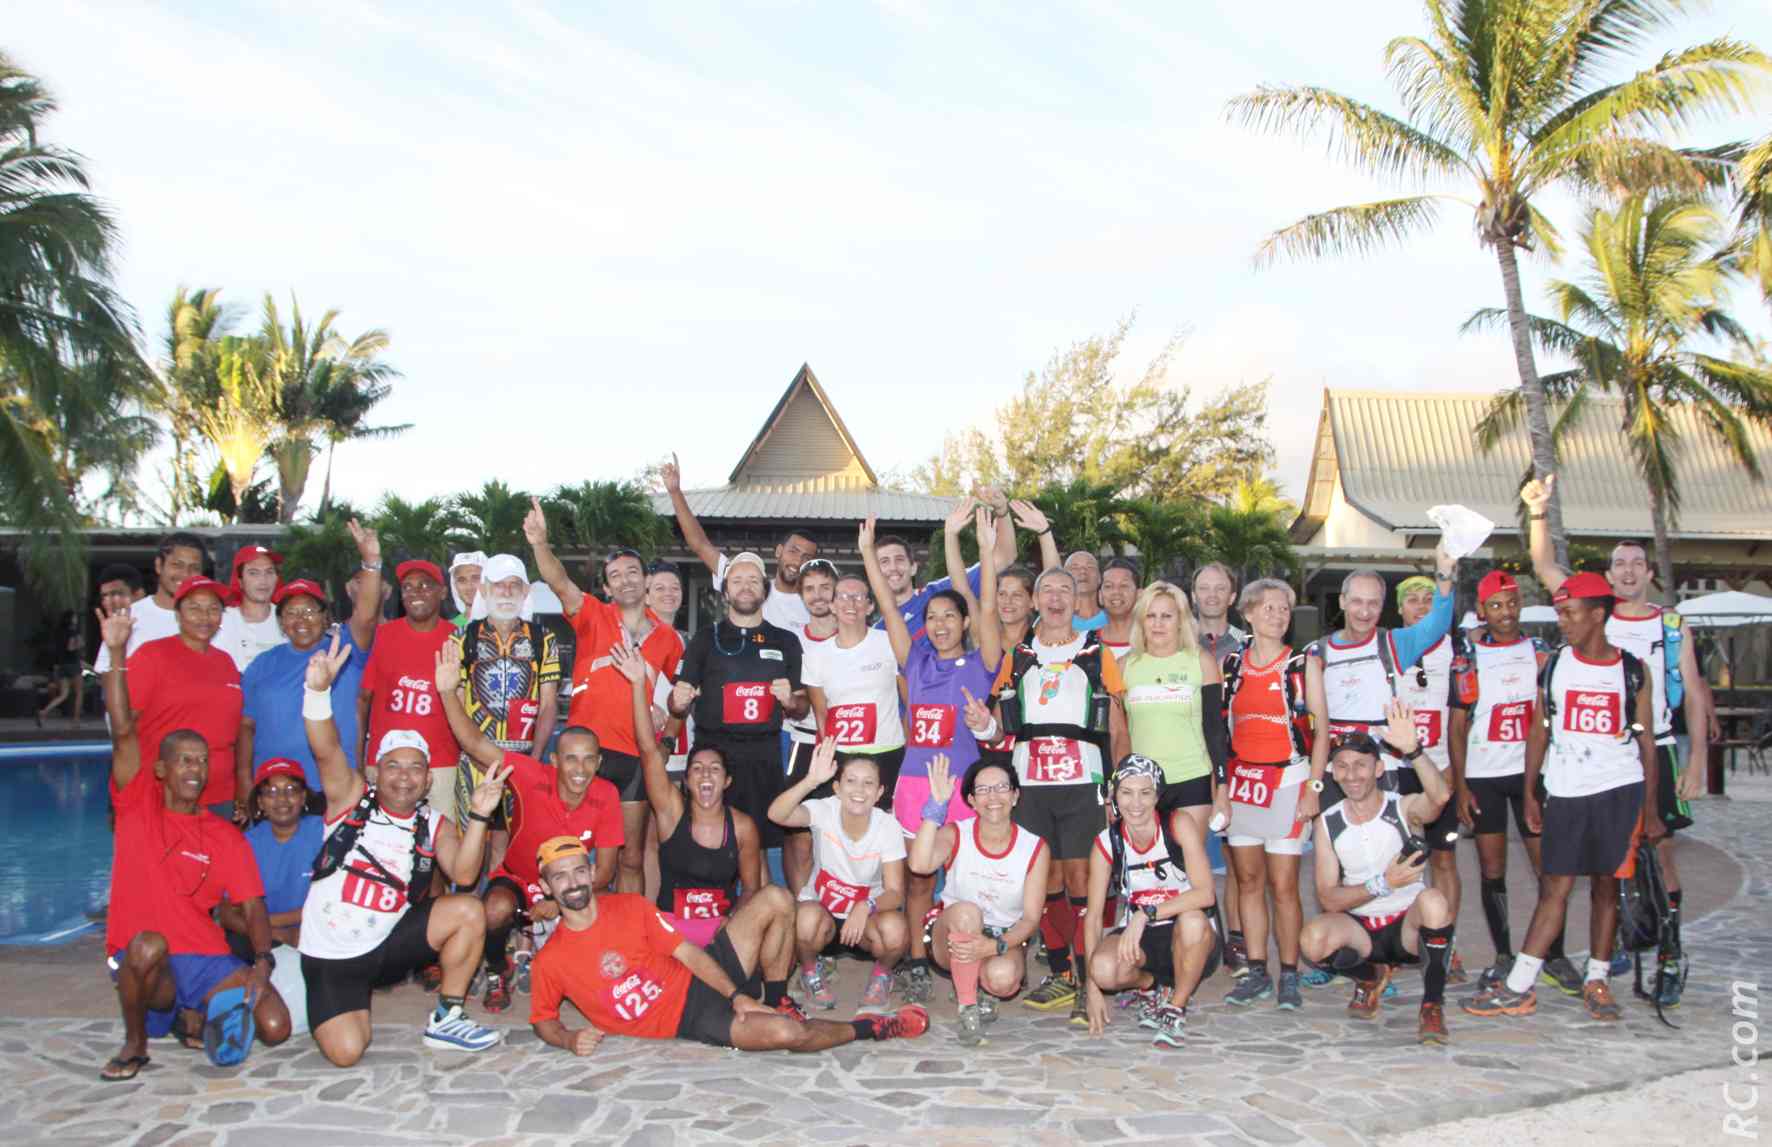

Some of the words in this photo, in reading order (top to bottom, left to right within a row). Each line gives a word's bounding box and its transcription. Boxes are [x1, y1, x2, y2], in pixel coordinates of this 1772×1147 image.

[390, 689, 433, 716] 318
[743, 698, 759, 721] 8
[520, 717, 536, 740] 7
[834, 720, 865, 743] 22
[915, 720, 941, 744] 34
[1499, 719, 1523, 741] 51
[1570, 708, 1613, 733] 166
[1229, 776, 1267, 804] 140
[352, 877, 397, 911] 118
[818, 885, 856, 914] 171
[614, 979, 660, 1021] 125
